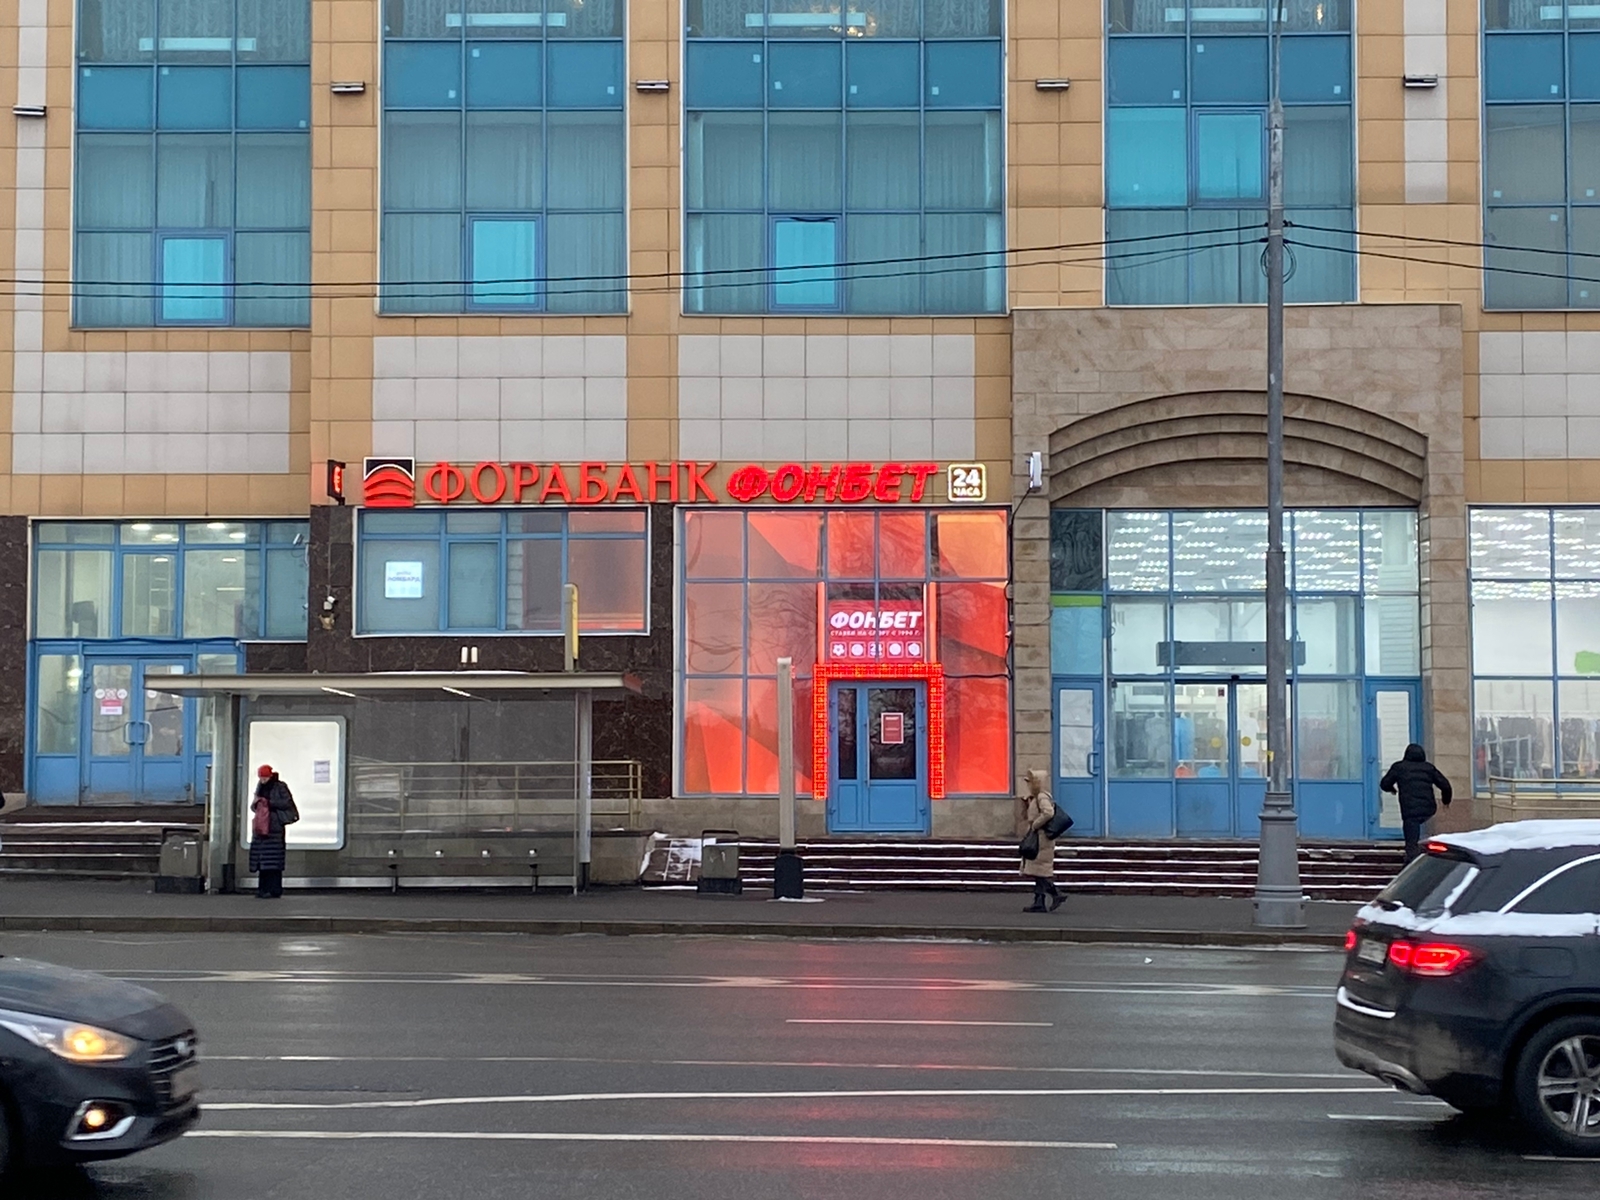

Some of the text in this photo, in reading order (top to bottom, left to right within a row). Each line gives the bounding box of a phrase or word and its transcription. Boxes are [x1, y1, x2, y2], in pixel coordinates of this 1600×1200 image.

[423, 461, 718, 504] ФОРАБАНК
[726, 463, 938, 502] ФОНБЕТ
[953, 468, 981, 487] 24
[953, 487, 981, 497] ЧАСА
[830, 611, 922, 629] ФОНБЕТ
